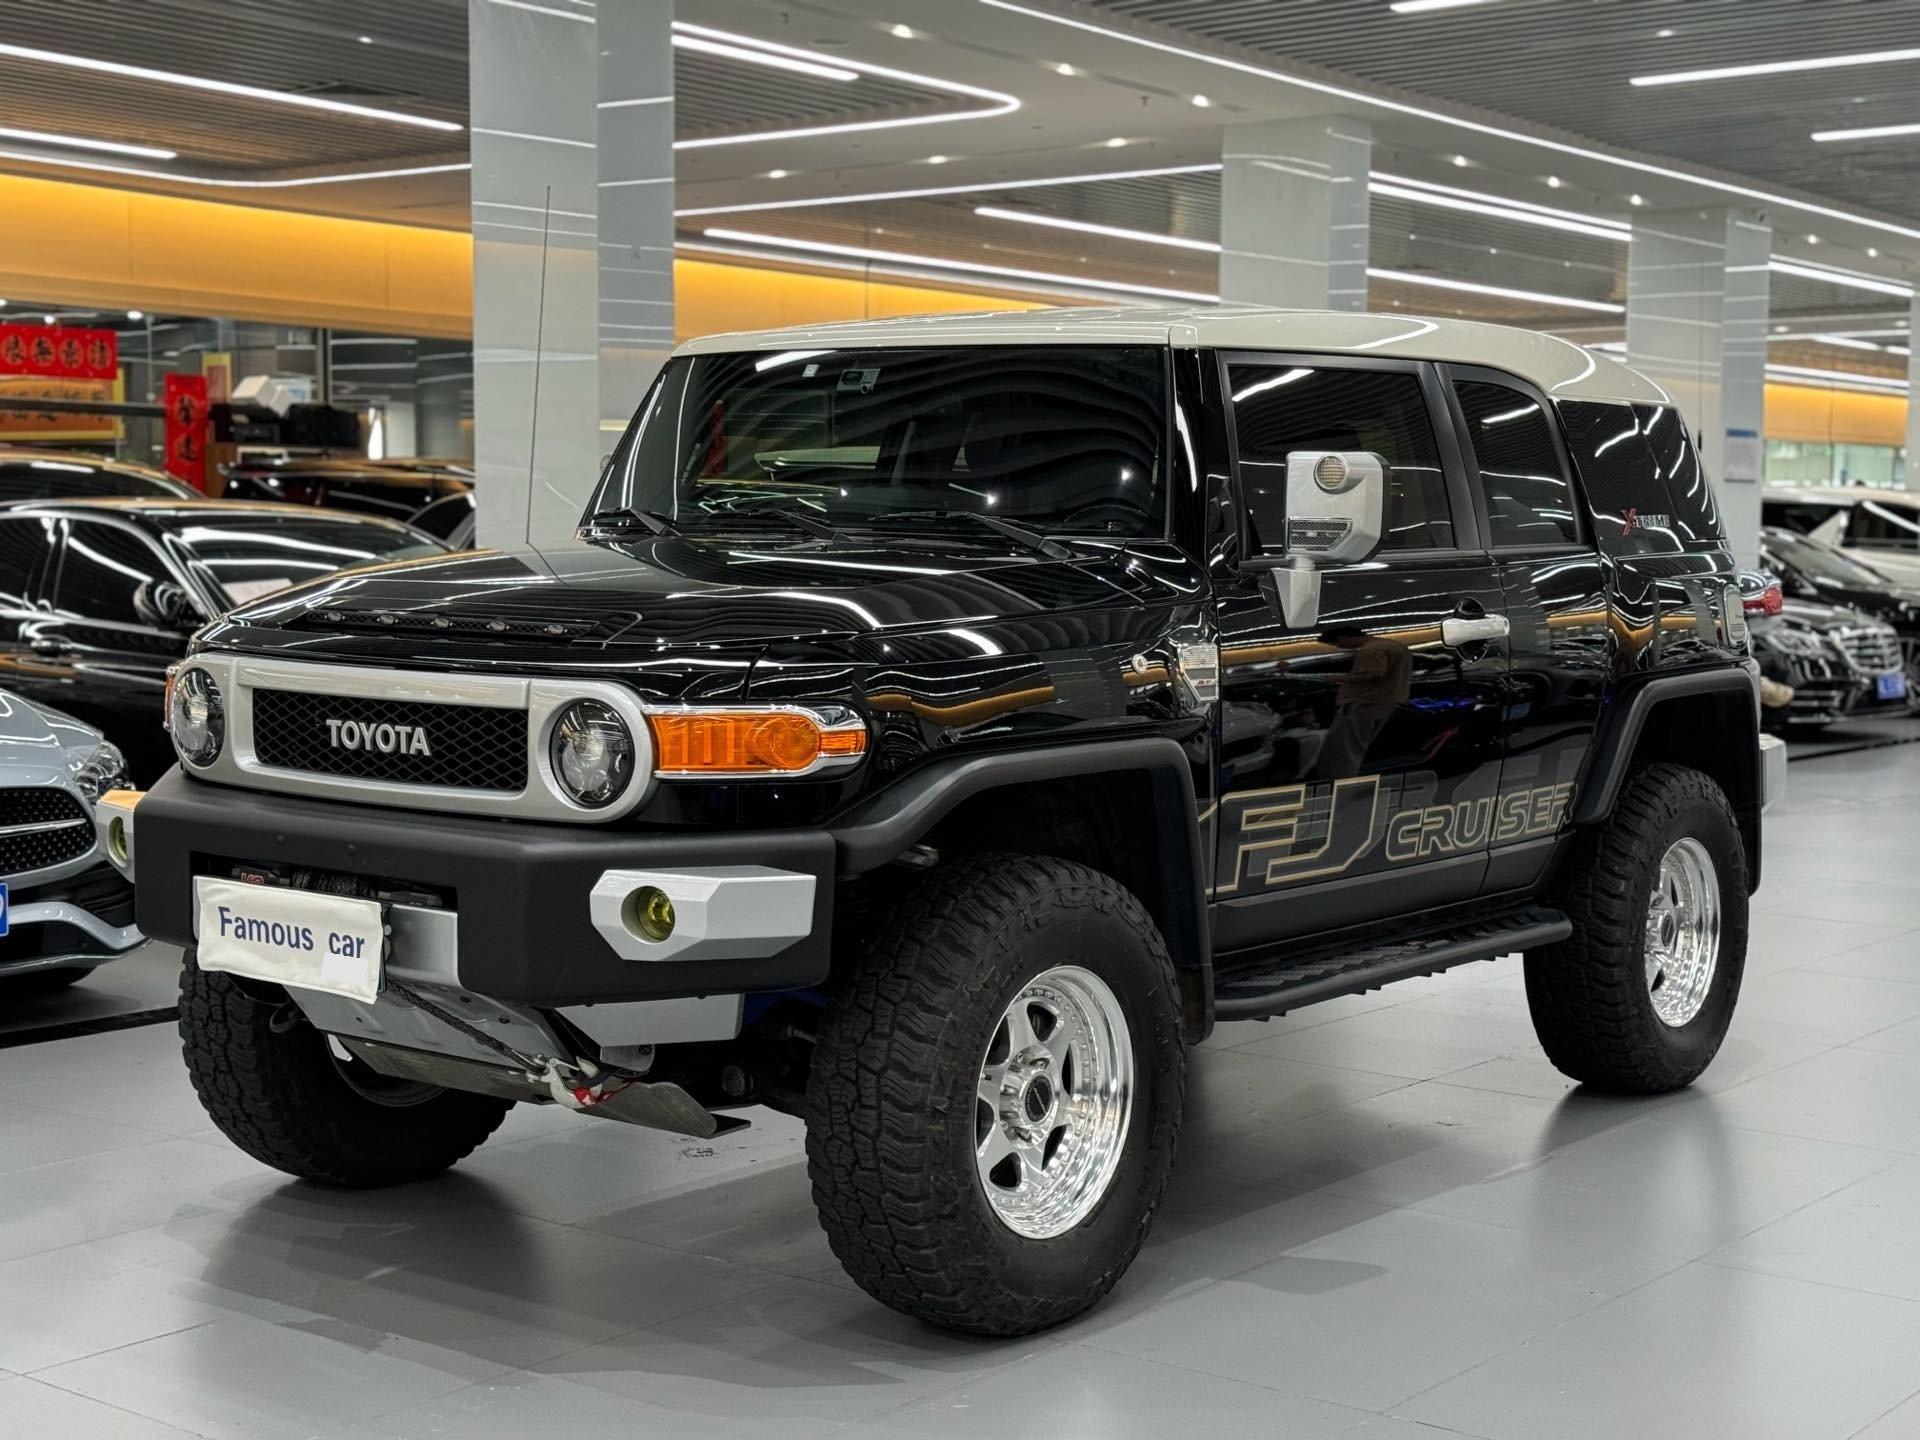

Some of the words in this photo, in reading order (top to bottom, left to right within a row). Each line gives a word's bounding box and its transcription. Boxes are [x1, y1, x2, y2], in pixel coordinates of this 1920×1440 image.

[326, 719, 432, 756] TOYOTA
[1199, 774, 1381, 895] FJ
[1385, 781, 1579, 862] CRUISER
[217, 906, 315, 951] Famous
[328, 931, 366, 958] car
